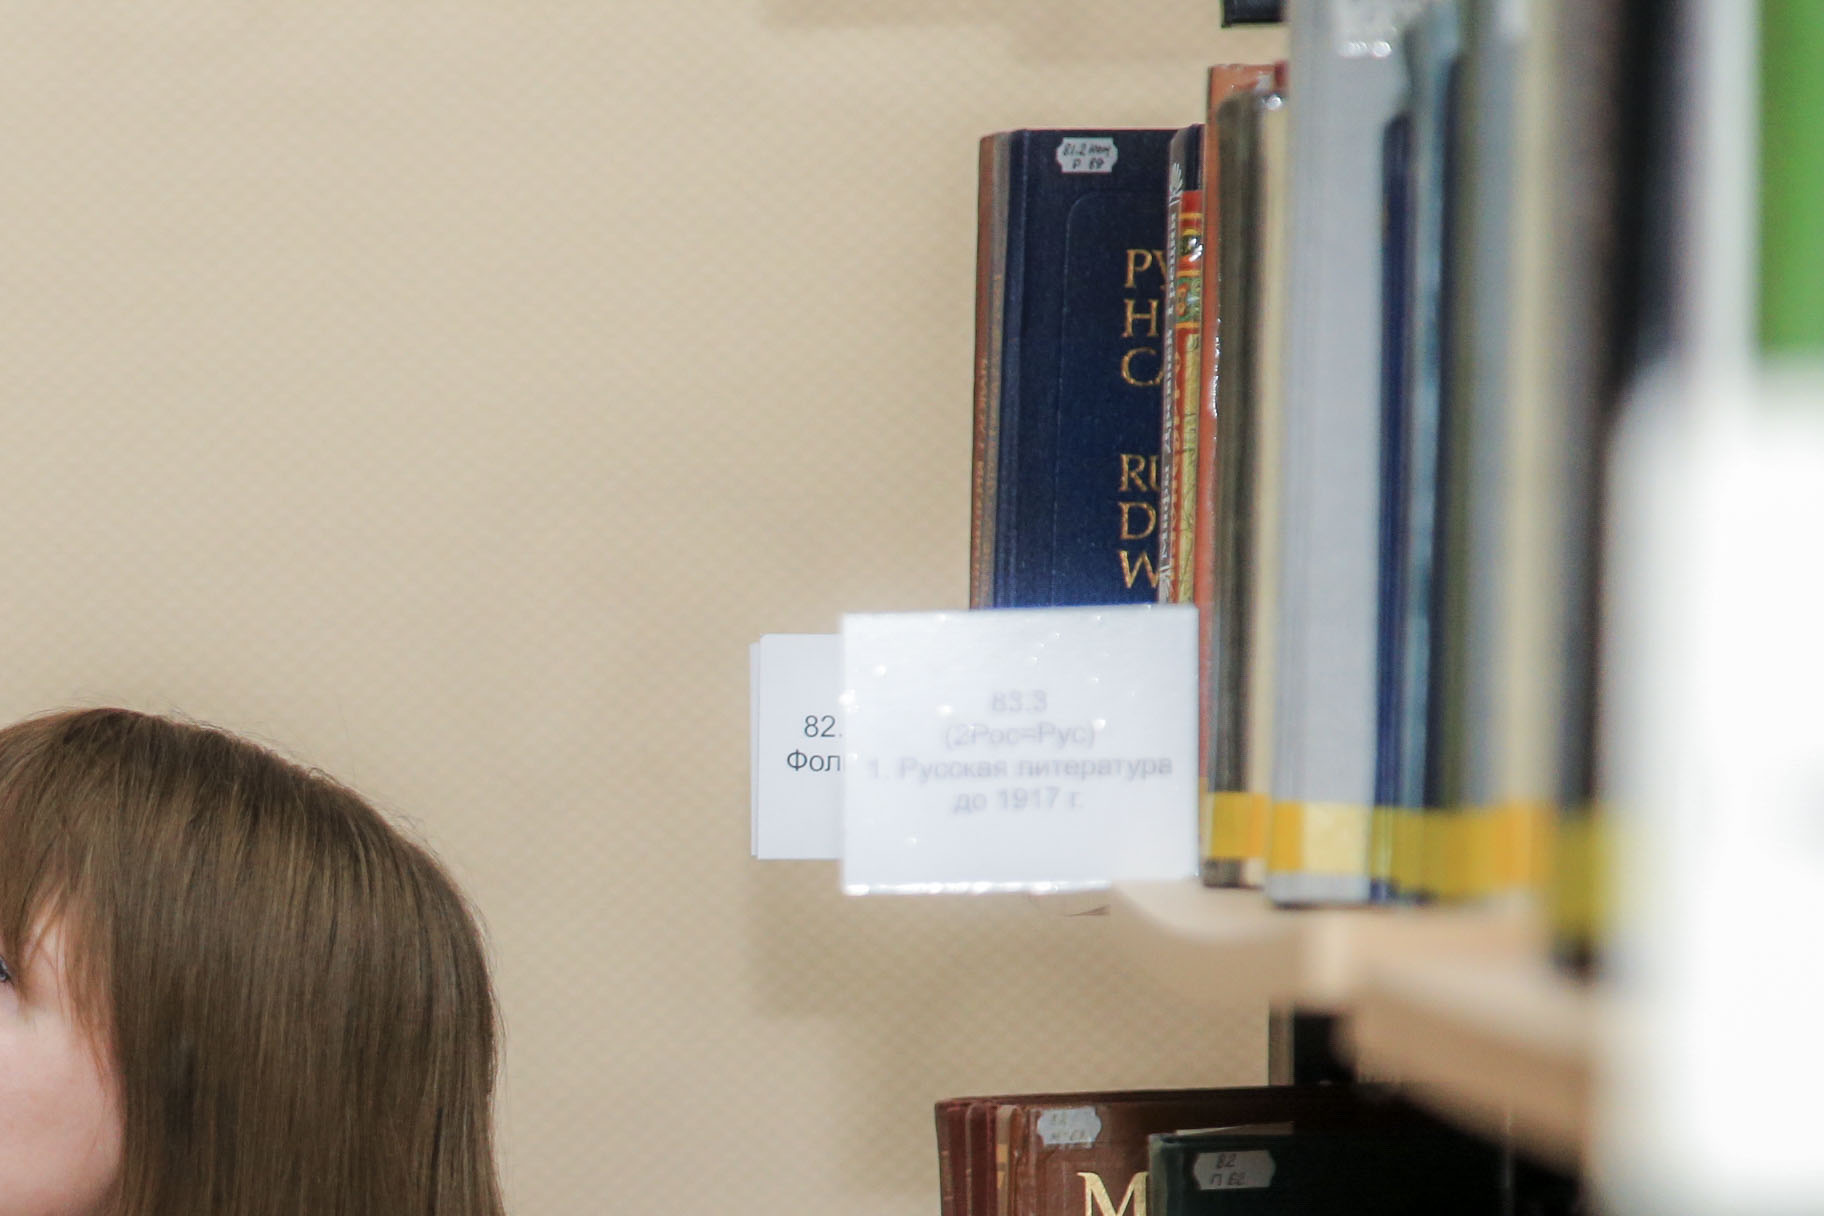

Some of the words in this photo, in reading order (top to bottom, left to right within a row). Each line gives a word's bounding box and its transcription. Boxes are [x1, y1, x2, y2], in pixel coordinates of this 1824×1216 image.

[989, 689, 1049, 713] 83.3
[786, 749, 844, 772] Фол
[900, 757, 1008, 783] Русская
[1018, 755, 1174, 782] литература
[952, 790, 987, 814] до
[998, 786, 1059, 810] 1917
